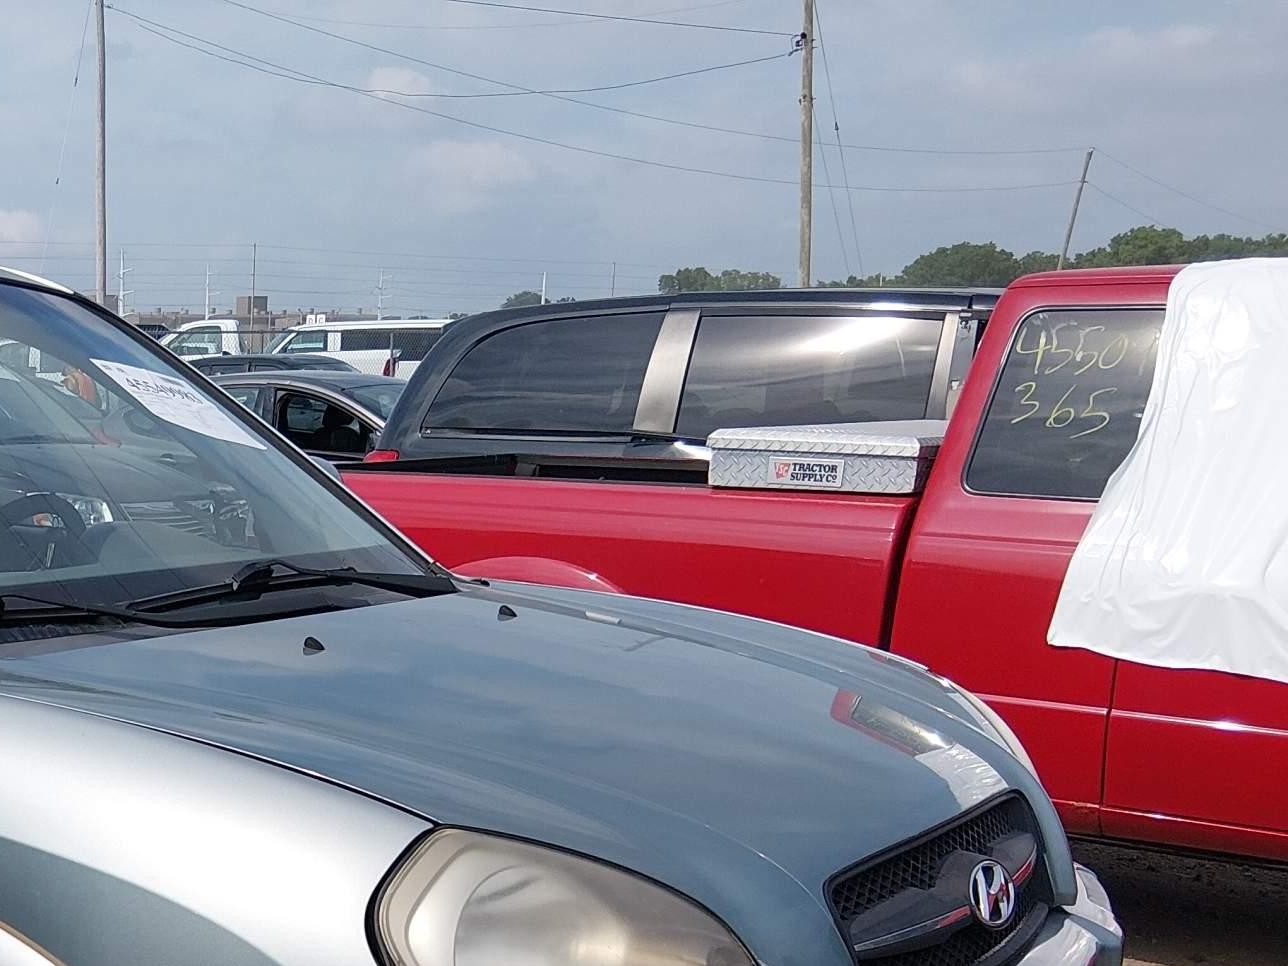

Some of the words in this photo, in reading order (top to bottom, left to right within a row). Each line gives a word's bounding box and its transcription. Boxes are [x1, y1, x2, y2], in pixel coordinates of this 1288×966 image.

[1010, 381, 1118, 439] 365
[792, 463, 838, 473] TRACTOR
[790, 472, 825, 482] SUPPLY
